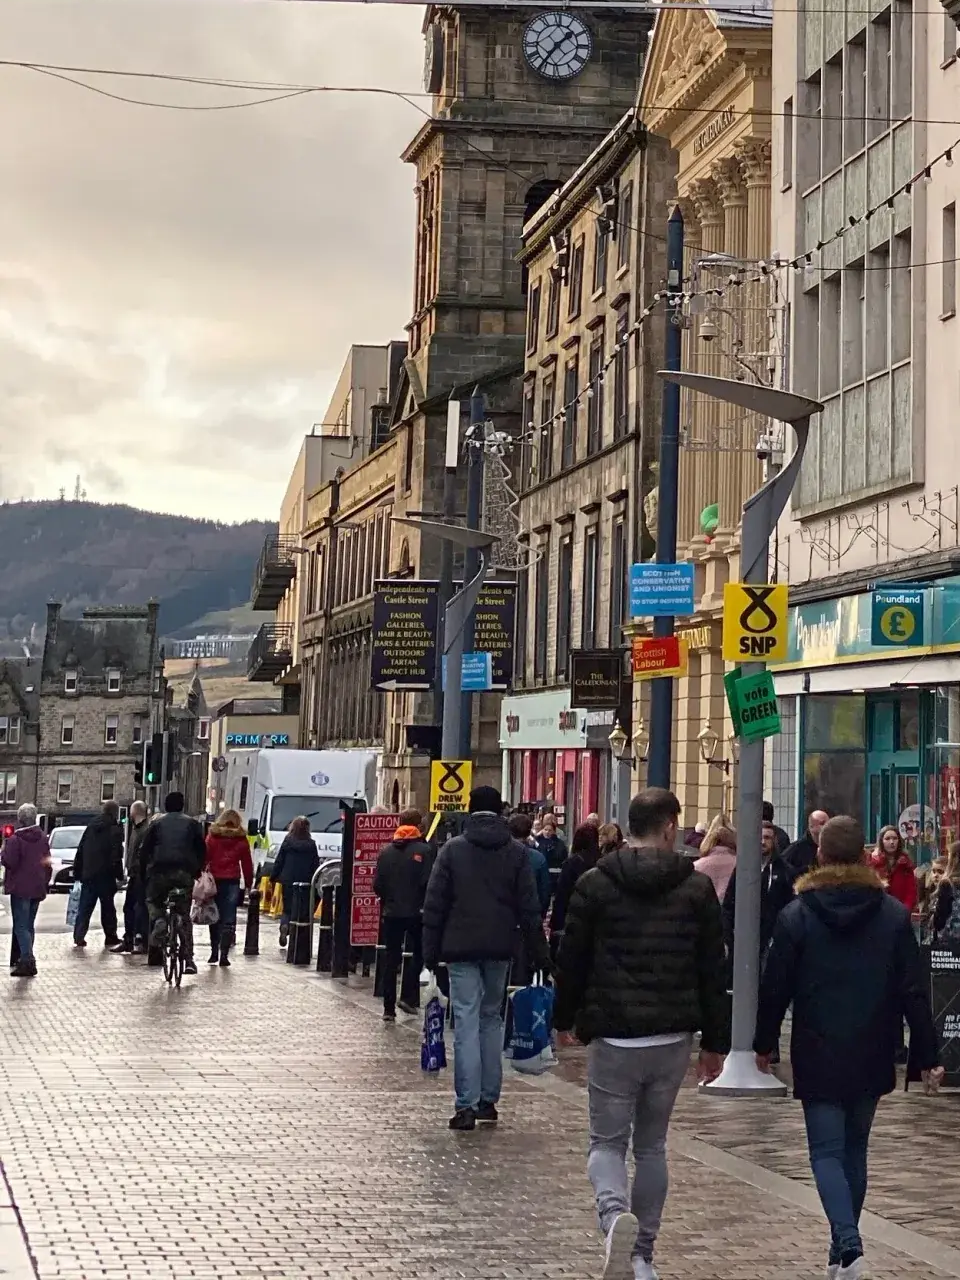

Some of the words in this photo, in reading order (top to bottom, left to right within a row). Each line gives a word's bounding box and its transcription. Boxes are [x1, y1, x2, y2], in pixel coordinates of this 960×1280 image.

[632, 577, 692, 585] CONSERVATIVE
[378, 584, 425, 596] Independents
[384, 595, 407, 604] Castle
[408, 596, 428, 604] Street
[485, 597, 505, 605] Street
[875, 594, 921, 604] Poundland
[739, 636, 777, 655] SNP
[635, 646, 667, 660] Scottish
[635, 659, 666, 670] Labour
[744, 686, 769, 703] vote
[741, 701, 778, 724] GREEN
[226, 735, 288, 744] PRIMRK
[438, 795, 462, 803] DREW
[433, 803, 467, 811] HENDRY
[357, 817, 400, 828] CAUTION
[317, 844, 342, 852] LICE
[358, 867, 376, 875] ST
